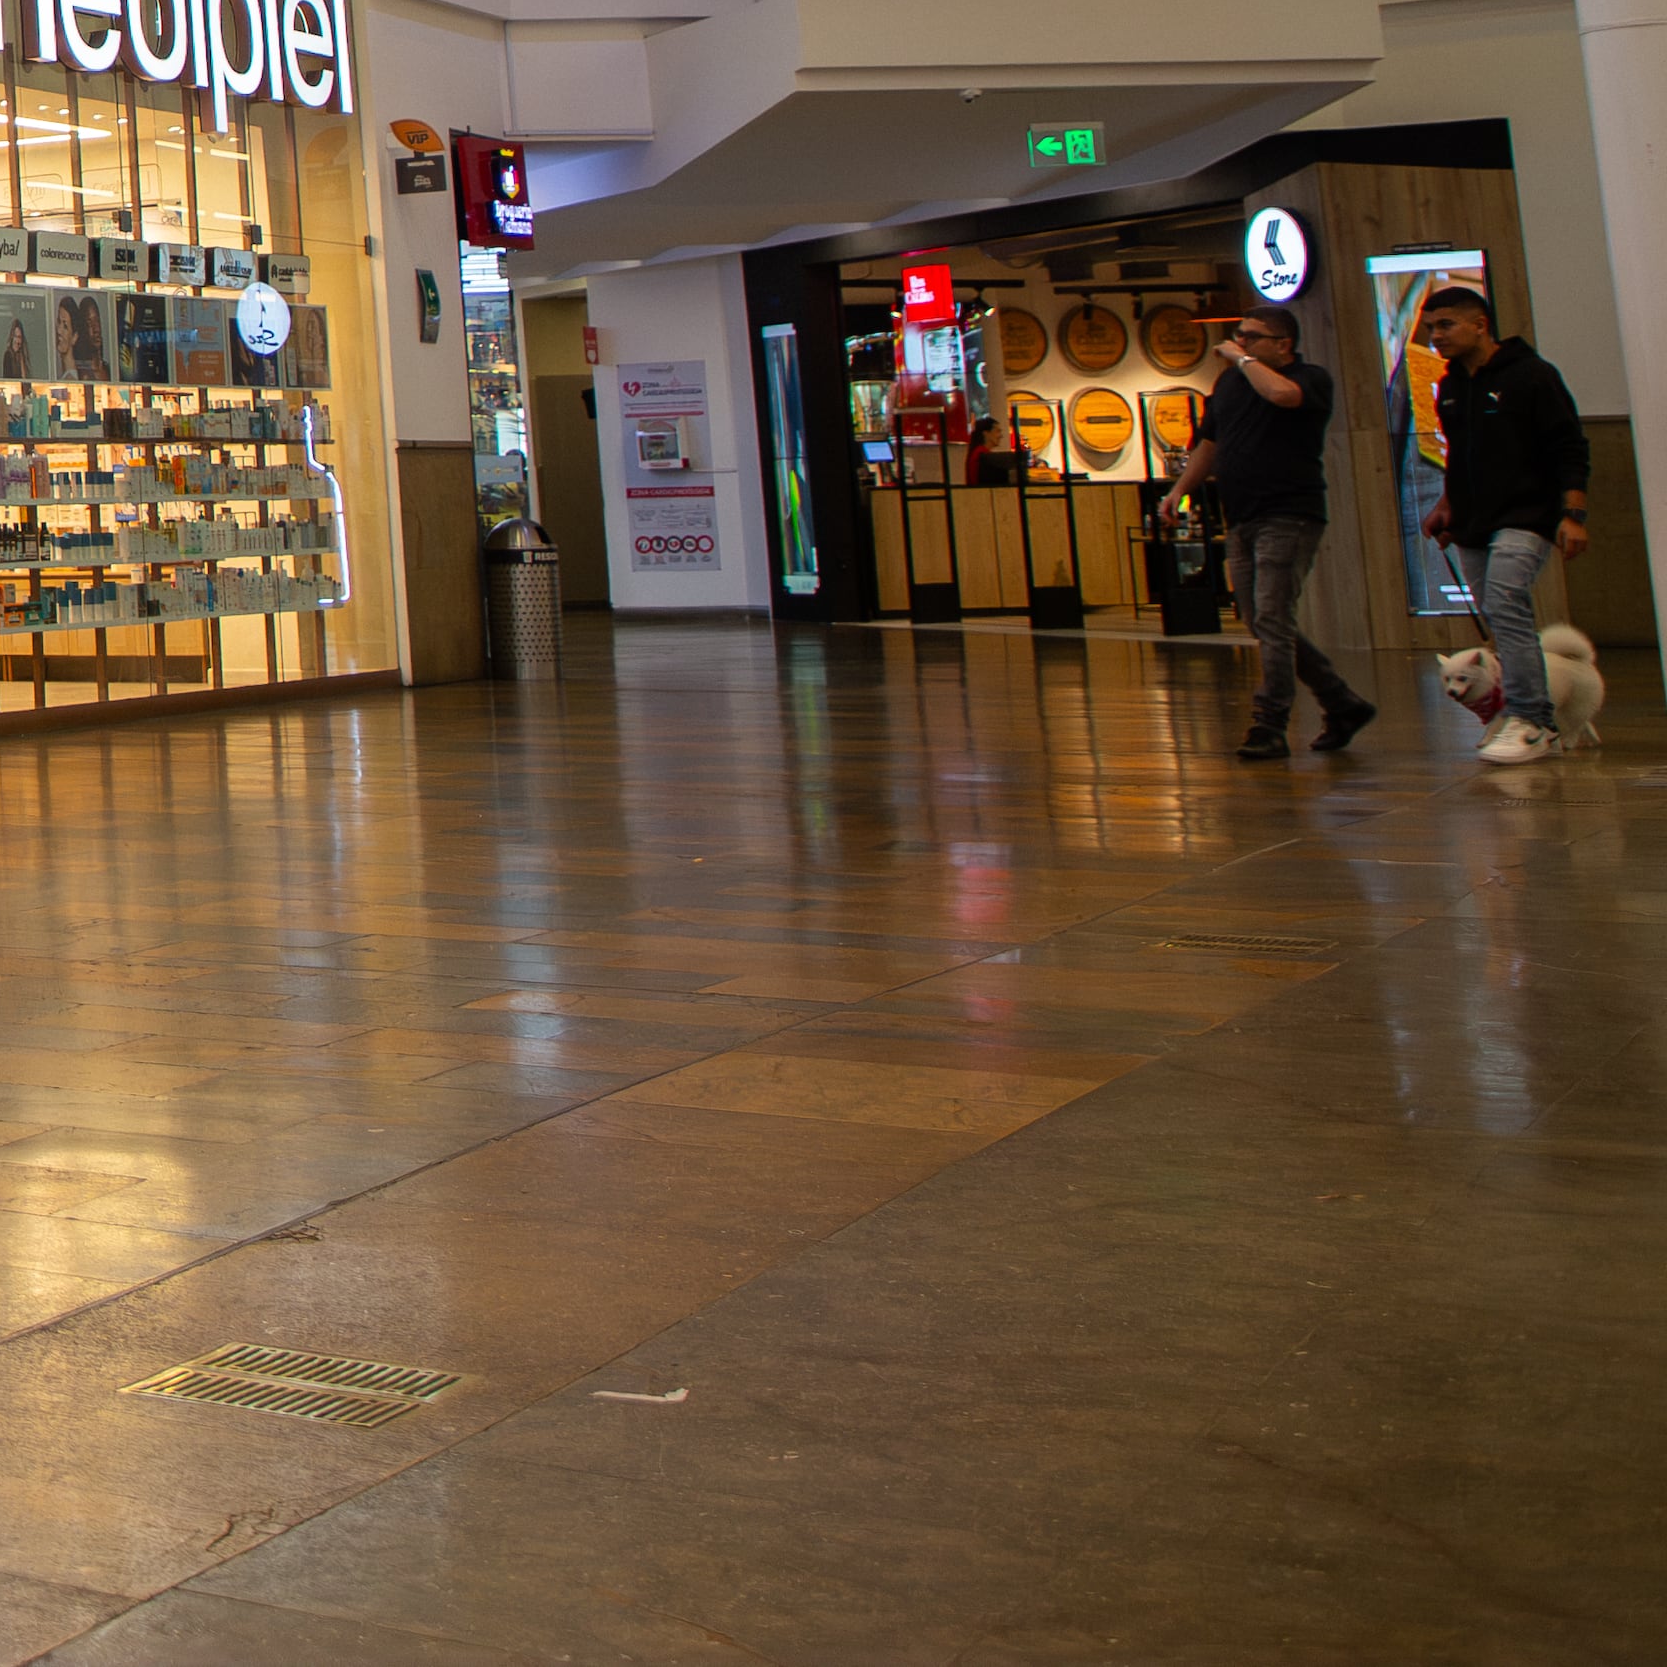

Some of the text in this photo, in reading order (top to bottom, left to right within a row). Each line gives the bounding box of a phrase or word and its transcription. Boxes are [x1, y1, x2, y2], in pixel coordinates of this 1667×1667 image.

[407, 133, 430, 145] VIP
[40, 248, 86, 262] colorescience
[1260, 269, 1298, 290] Store
